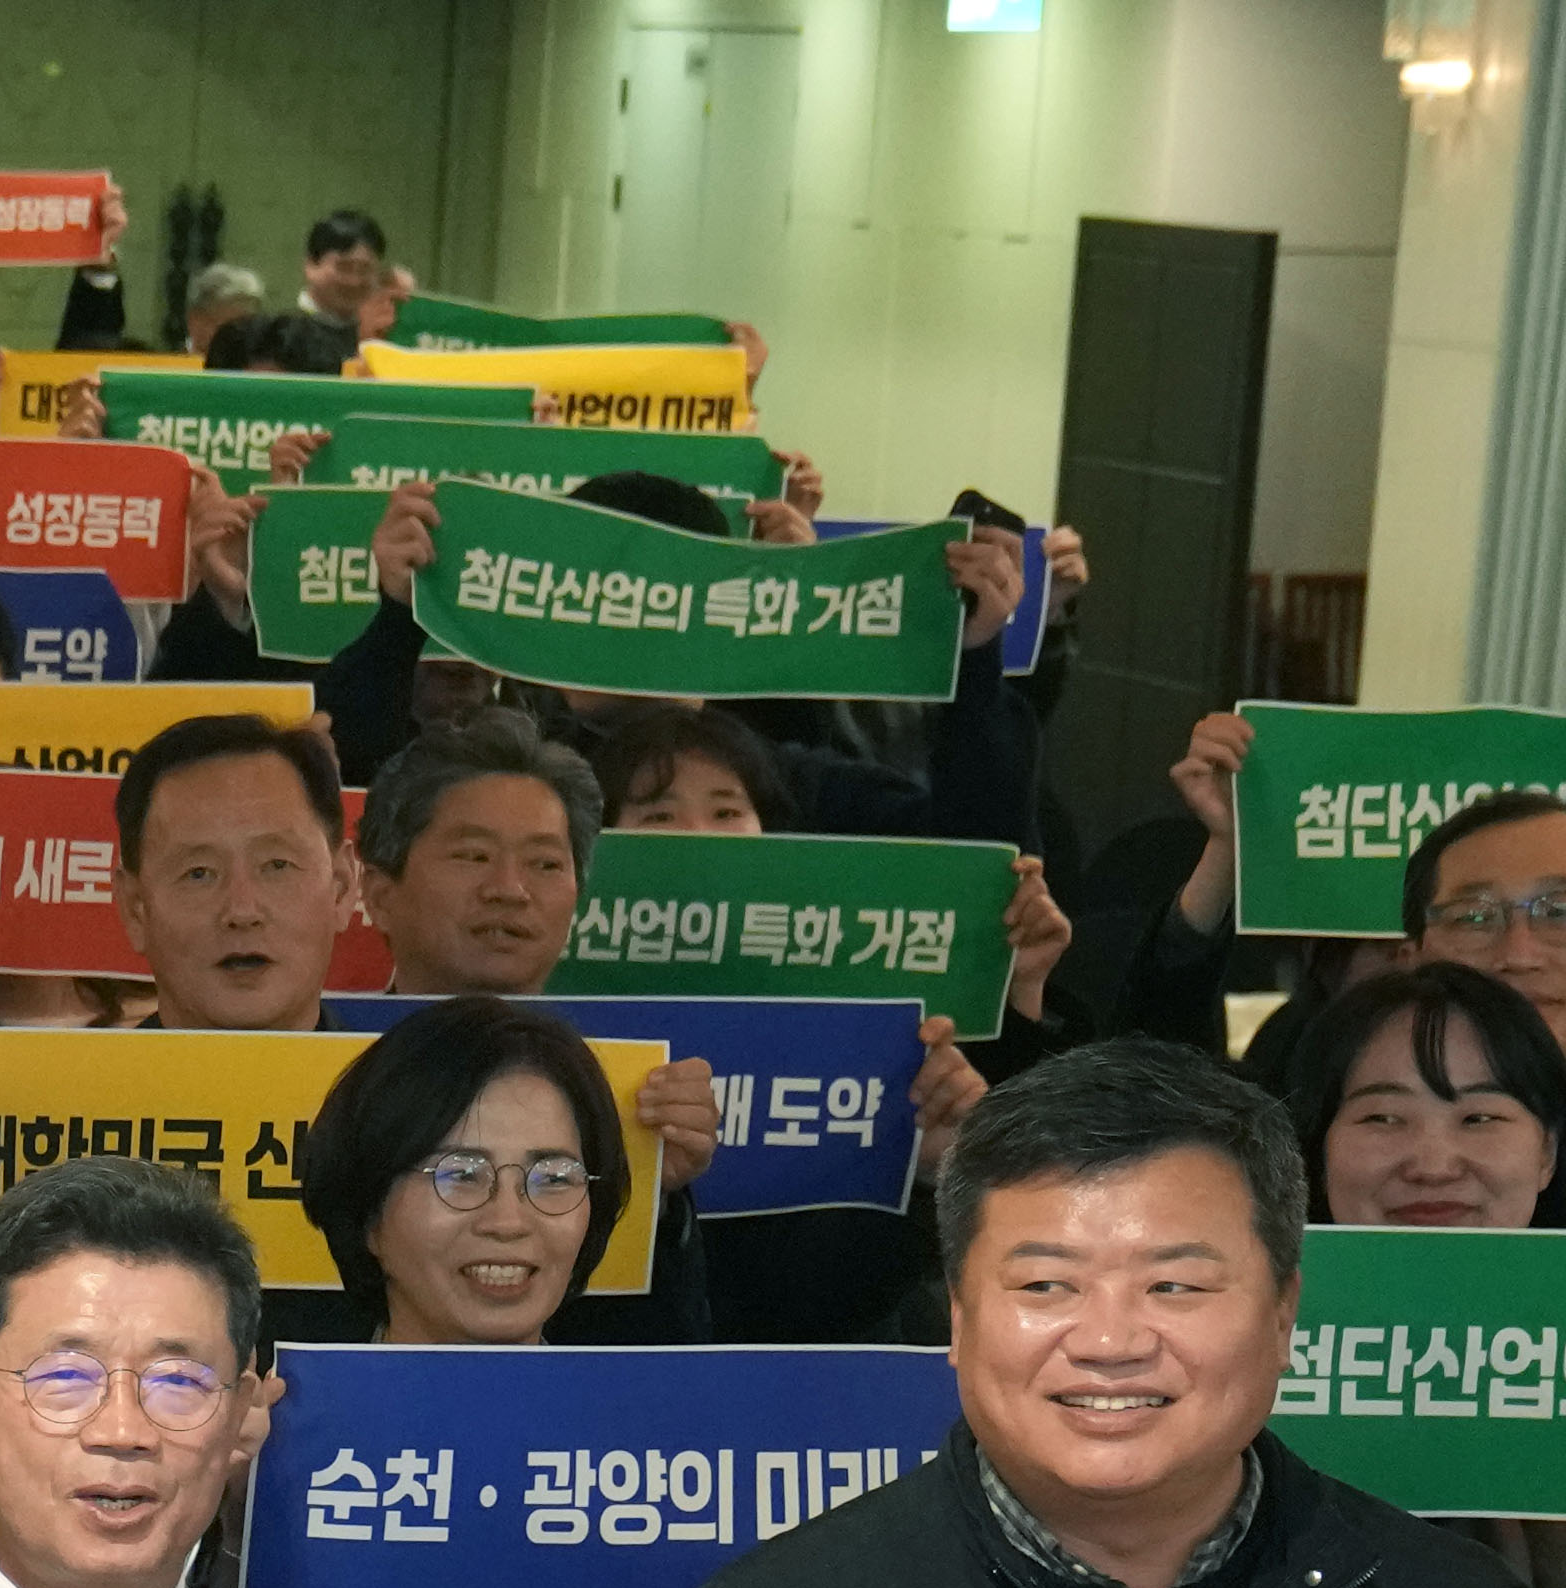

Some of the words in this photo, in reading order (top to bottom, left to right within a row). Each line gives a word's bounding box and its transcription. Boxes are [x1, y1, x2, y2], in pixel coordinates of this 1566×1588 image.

[7, 493, 162, 549] 성장동력
[458, 548, 693, 632] 첨단산업의
[705, 578, 800, 637] 특화
[808, 575, 903, 635] 거점
[21, 629, 107, 681] 도약
[740, 903, 842, 966] 특화
[849, 909, 955, 973] 거점
[764, 1077, 884, 1147] 도약
[307, 1449, 453, 1541] 순천
[524, 1449, 733, 1544] 광양의
